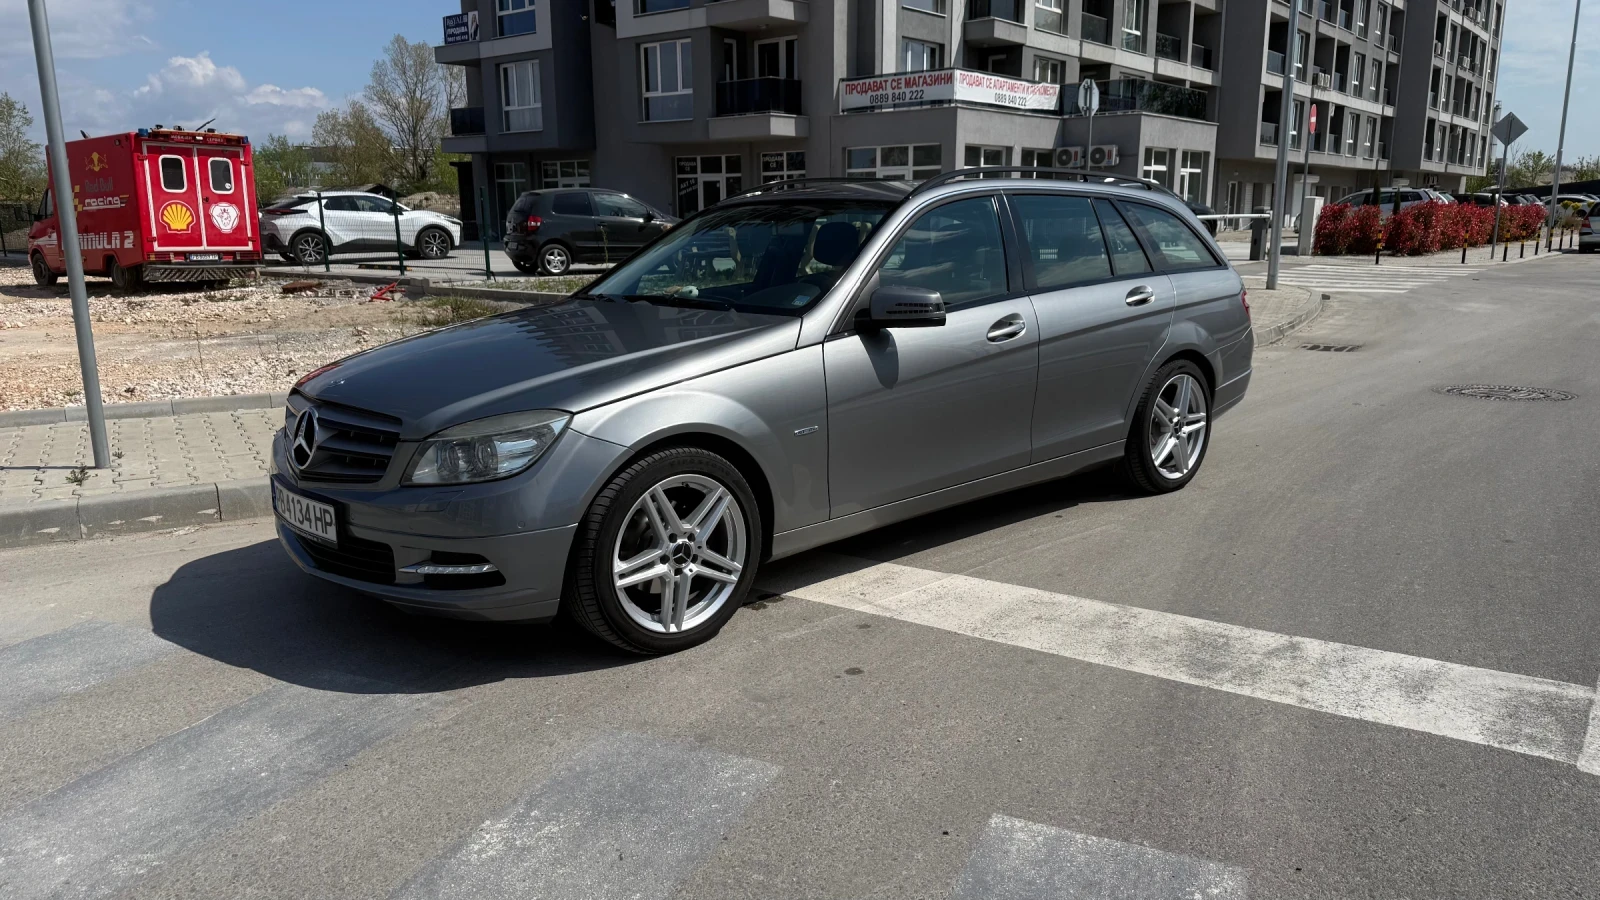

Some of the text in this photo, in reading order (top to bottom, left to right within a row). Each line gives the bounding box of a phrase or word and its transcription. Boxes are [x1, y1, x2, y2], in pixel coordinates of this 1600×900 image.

[845, 72, 953, 96] ПРОДАВАТ СЕ МАГАЗИНИ
[959, 72, 986, 89] ПРОДАВАТ
[986, 78, 993, 89] СЕ
[993, 80, 1026, 95] АПАРТАМЕНТИ
[869, 89, 925, 105] 0889 840 222
[994, 92, 1027, 107] 0889 840 222
[84, 177, 113, 193] Red Bull
[85, 195, 120, 208] racing
[124, 230, 134, 249] 2
